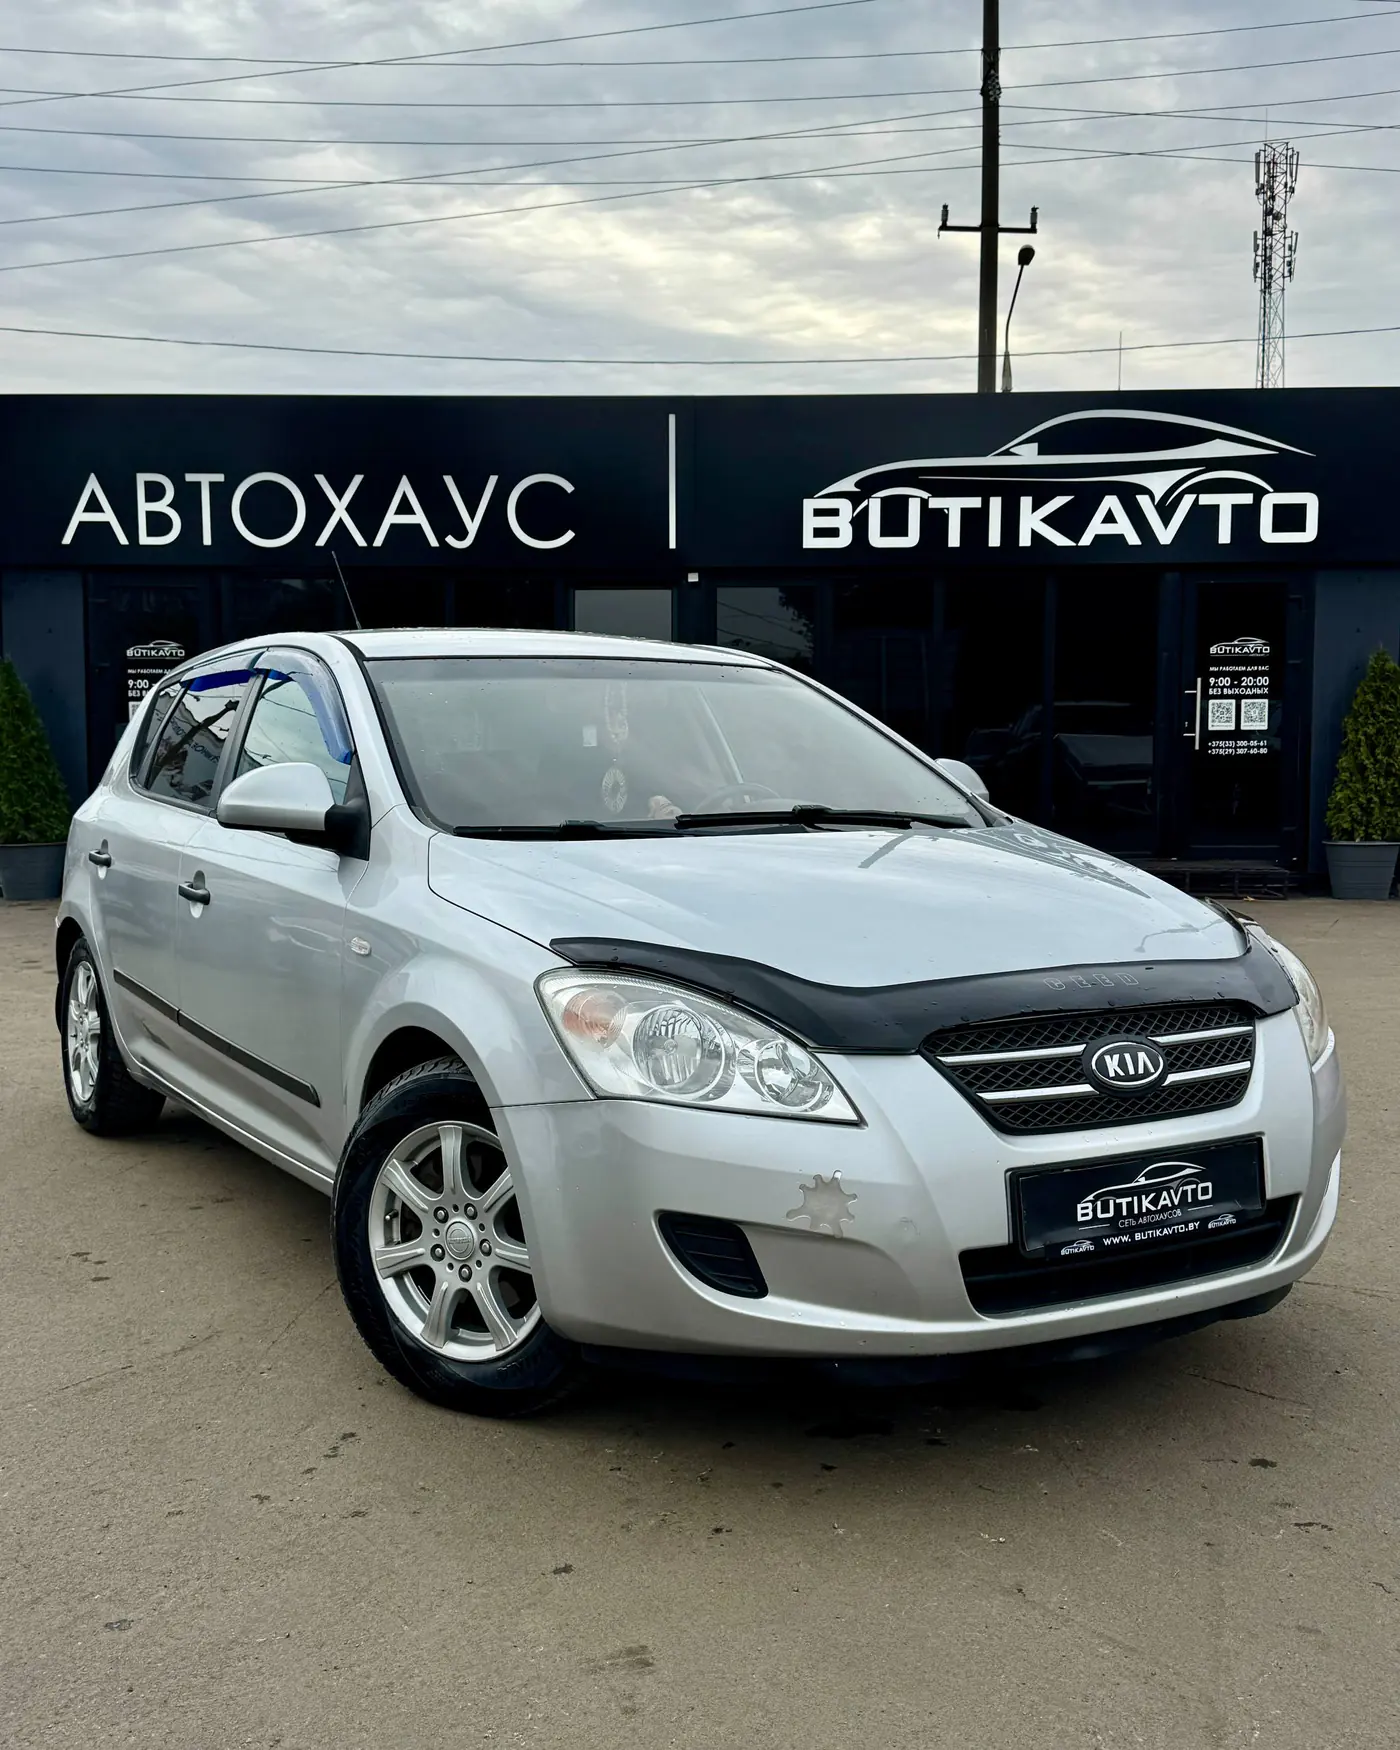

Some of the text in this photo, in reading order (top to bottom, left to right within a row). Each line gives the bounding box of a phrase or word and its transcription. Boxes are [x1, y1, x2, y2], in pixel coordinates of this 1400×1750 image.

[61, 471, 576, 549] АВТОХАУС
[802, 491, 1319, 549] BUTIKAVTO
[126, 649, 185, 657] BUTIKAVTO
[128, 680, 149, 689] 9:00
[1209, 677, 1231, 687] 9:00
[1241, 677, 1269, 686] 20:00
[1223, 687, 1269, 695] ВЫХОДНЫХ
[1208, 740, 1236, 748] +375(33)
[1104, 1051, 1156, 1078] KIA
[1076, 1181, 1213, 1222] BUTIKAVTO
[1118, 1208, 1183, 1229] СЕТЬ АВТОХАУСОВ
[1103, 1221, 1201, 1246] WWW. BUTIKAVTO.BY
